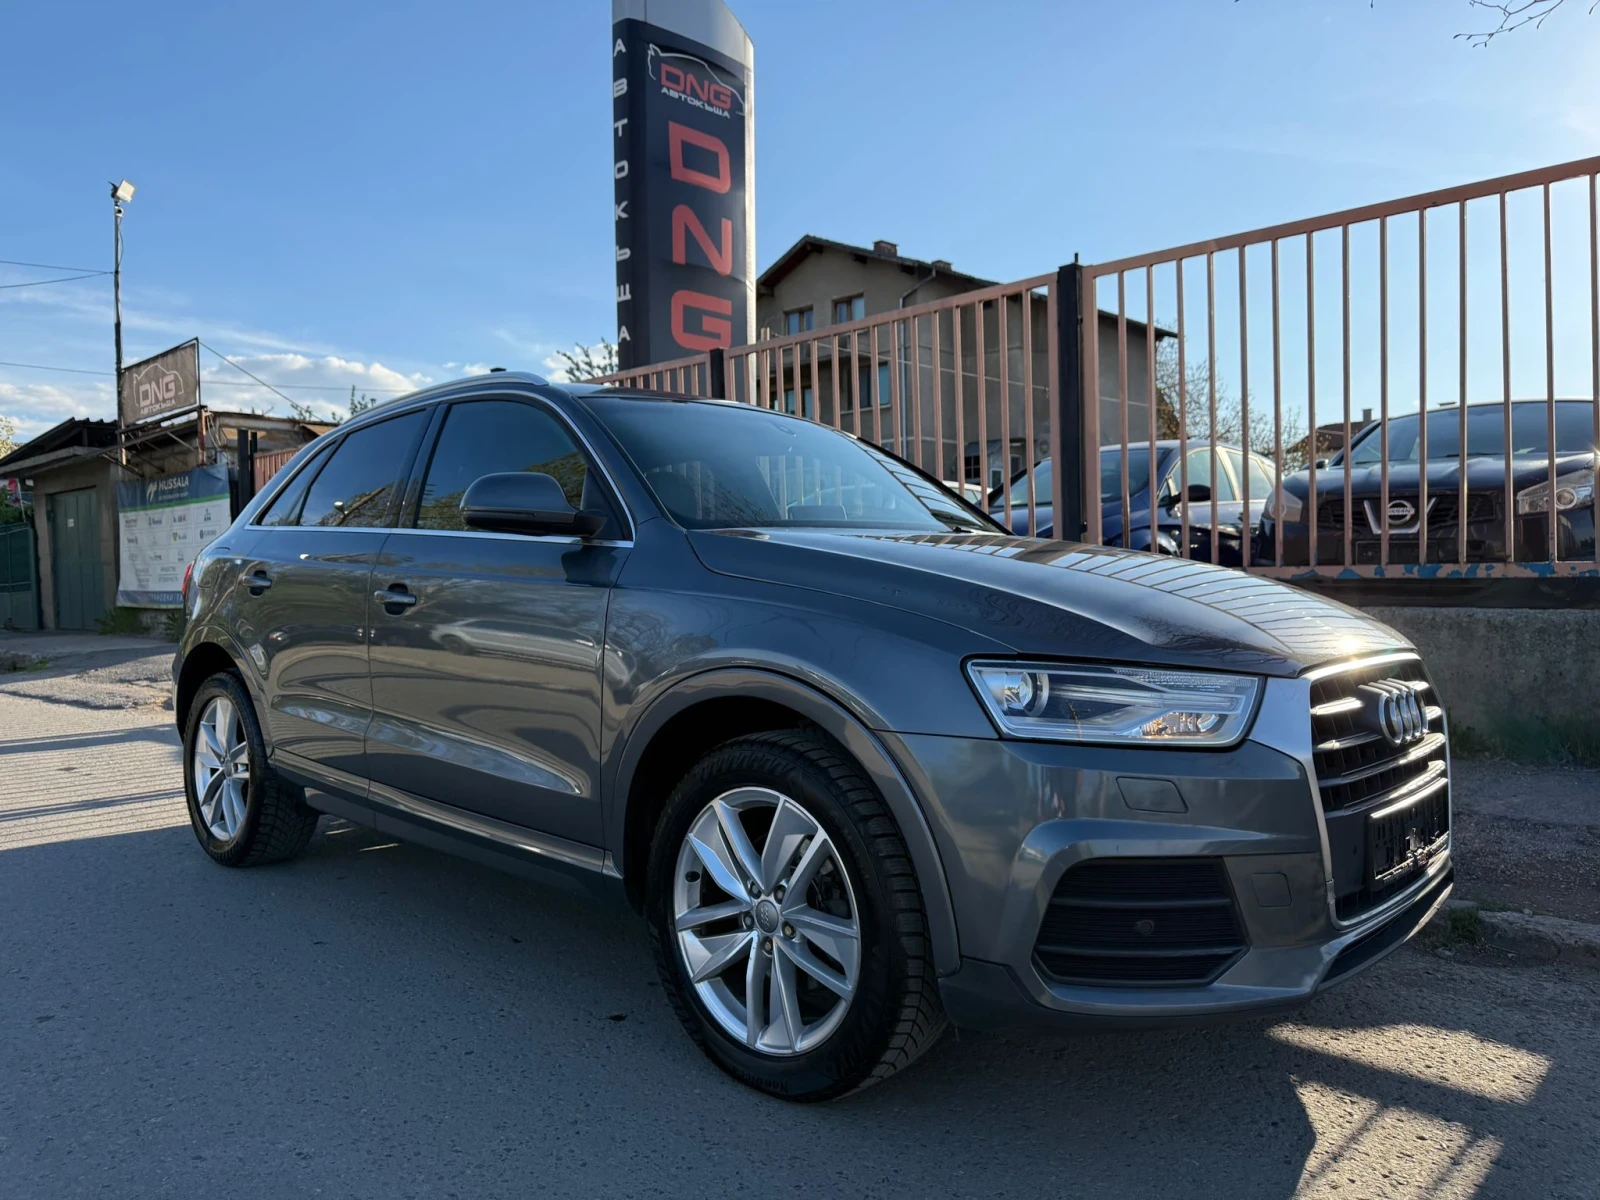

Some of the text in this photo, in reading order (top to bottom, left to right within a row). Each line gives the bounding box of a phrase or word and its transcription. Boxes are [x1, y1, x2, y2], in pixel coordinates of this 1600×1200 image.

[661, 63, 732, 110] DNG
[668, 120, 733, 352] DNG
[139, 374, 176, 408] DNG
